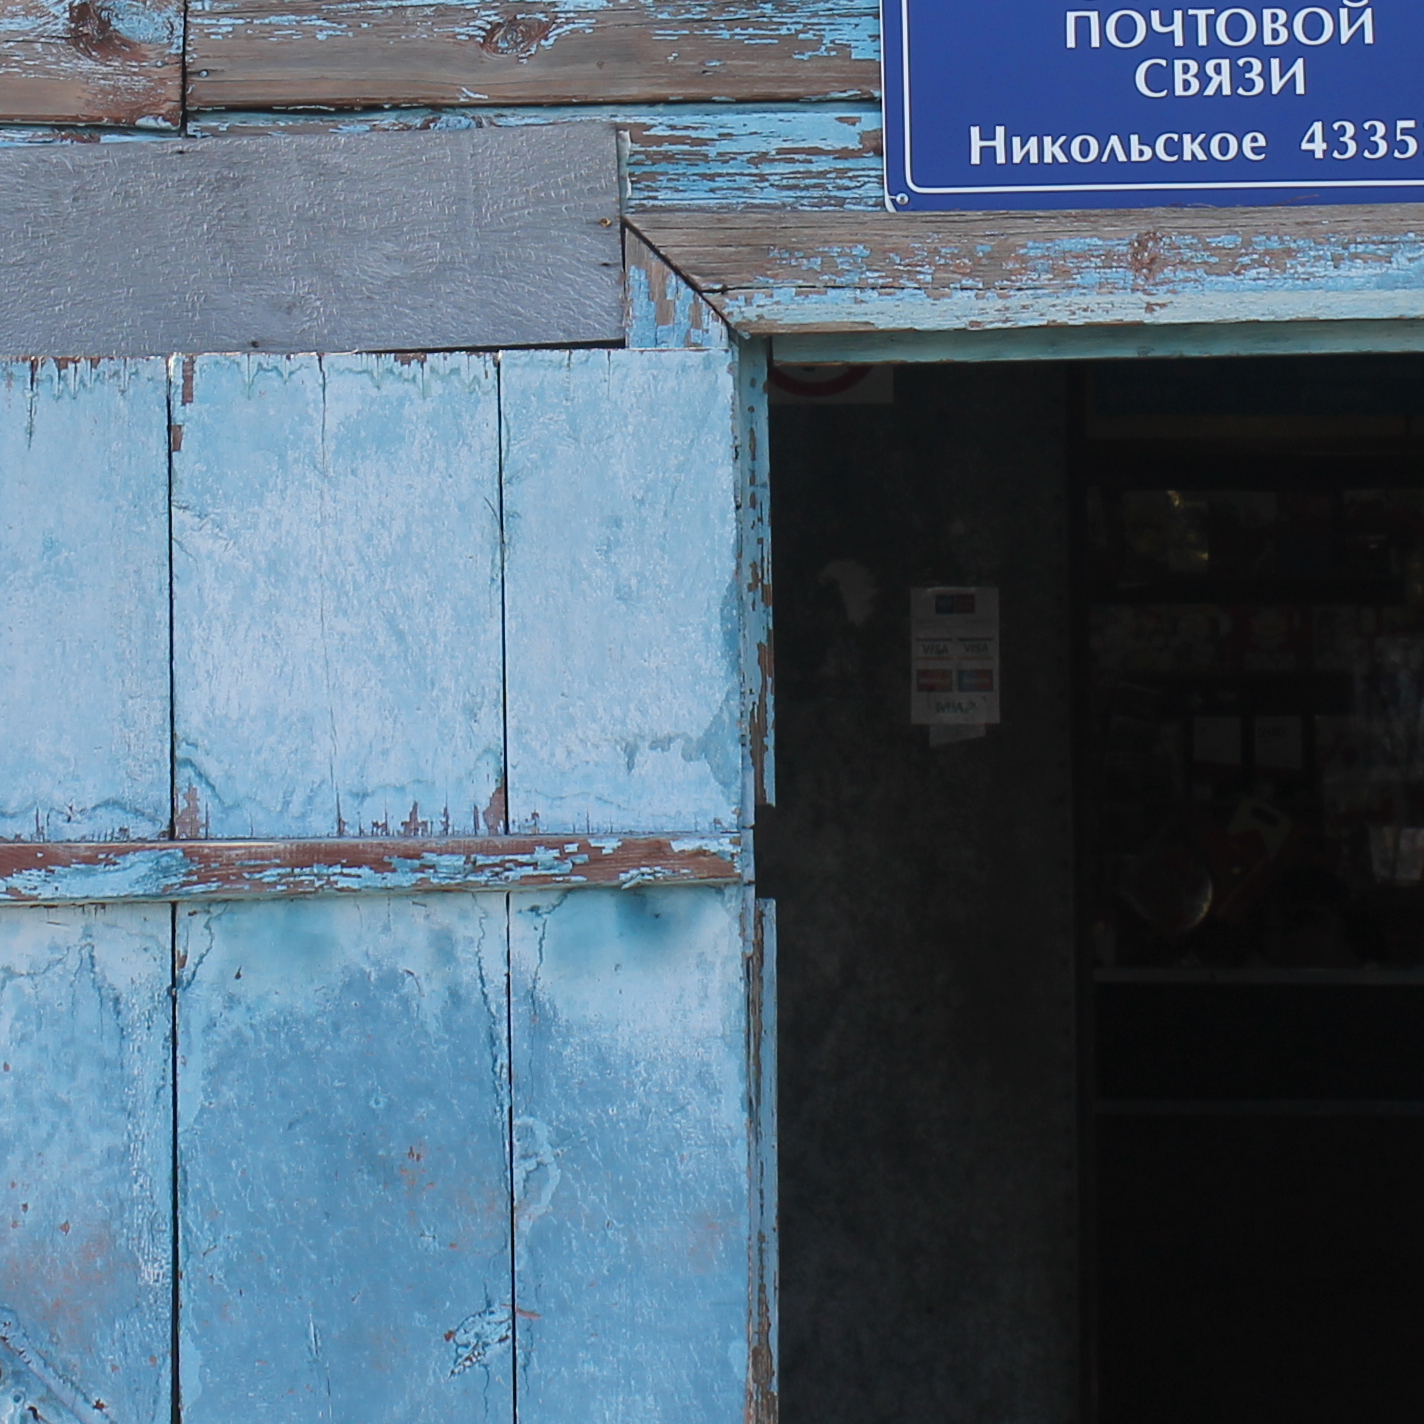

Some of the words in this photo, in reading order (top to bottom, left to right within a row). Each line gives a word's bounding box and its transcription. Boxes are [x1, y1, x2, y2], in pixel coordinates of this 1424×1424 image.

[1135, 57, 1306, 98] СВЯЗИ
[969, 124, 1267, 166] Никольское
[921, 643, 949, 655] VISA
[963, 642, 989, 654] VISA
